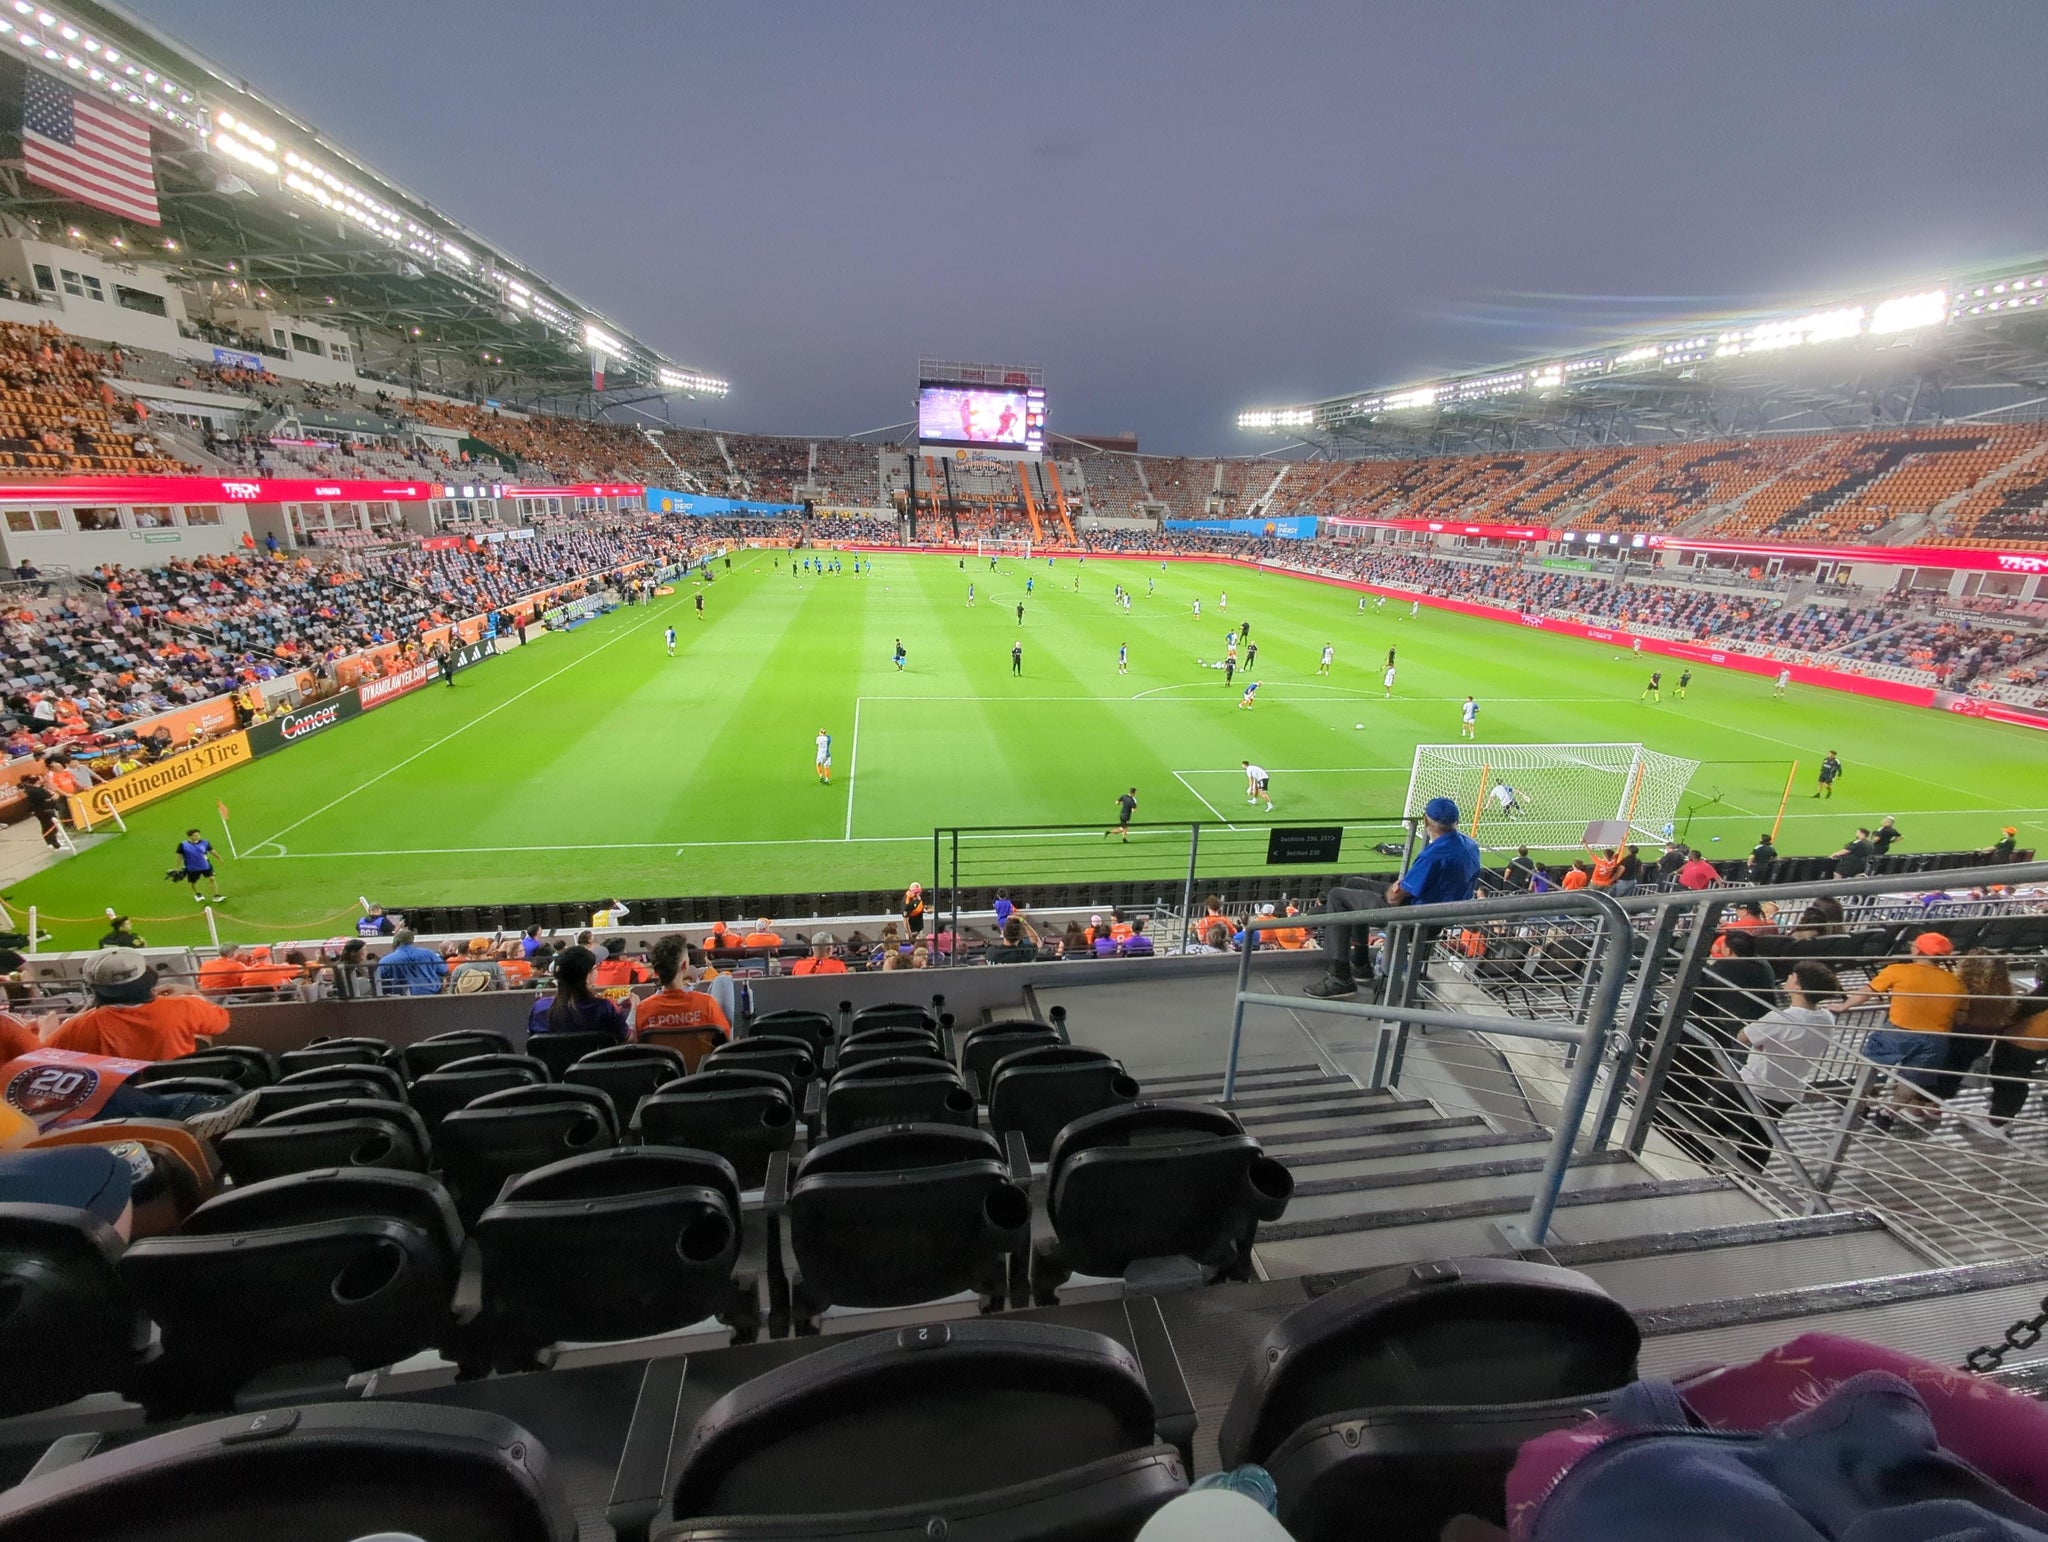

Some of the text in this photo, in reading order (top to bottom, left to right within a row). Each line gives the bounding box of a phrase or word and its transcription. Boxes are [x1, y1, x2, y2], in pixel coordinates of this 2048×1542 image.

[222, 483, 260, 493] TRON
[362, 664, 426, 702] DYNAMOLAWYER.COM
[92, 741, 239, 815] Continental Tire
[30, 1069, 84, 1095] 20
[918, 1328, 928, 1340] 2
